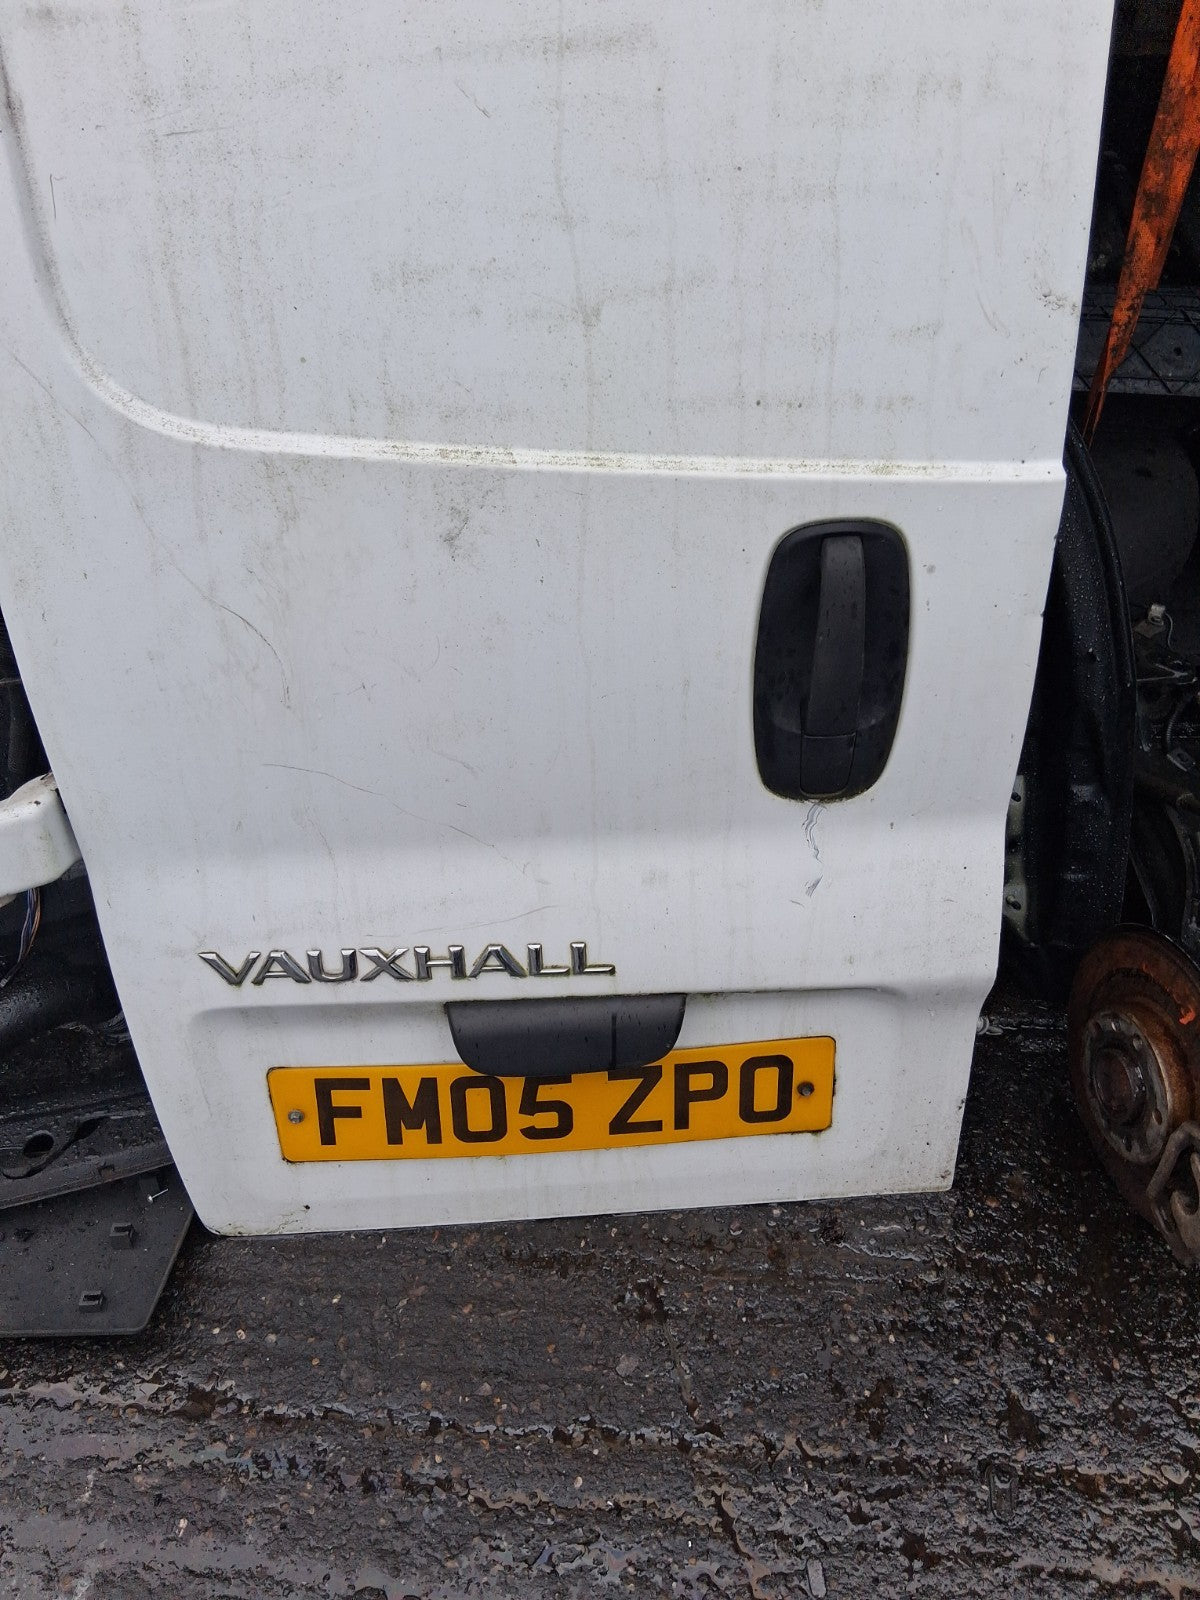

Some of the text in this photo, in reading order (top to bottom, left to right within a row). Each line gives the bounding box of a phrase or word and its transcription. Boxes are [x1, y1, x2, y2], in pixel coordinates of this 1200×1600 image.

[198, 942, 616, 986] VAUXHALL
[314, 1054, 794, 1146] FM05 ZPO
